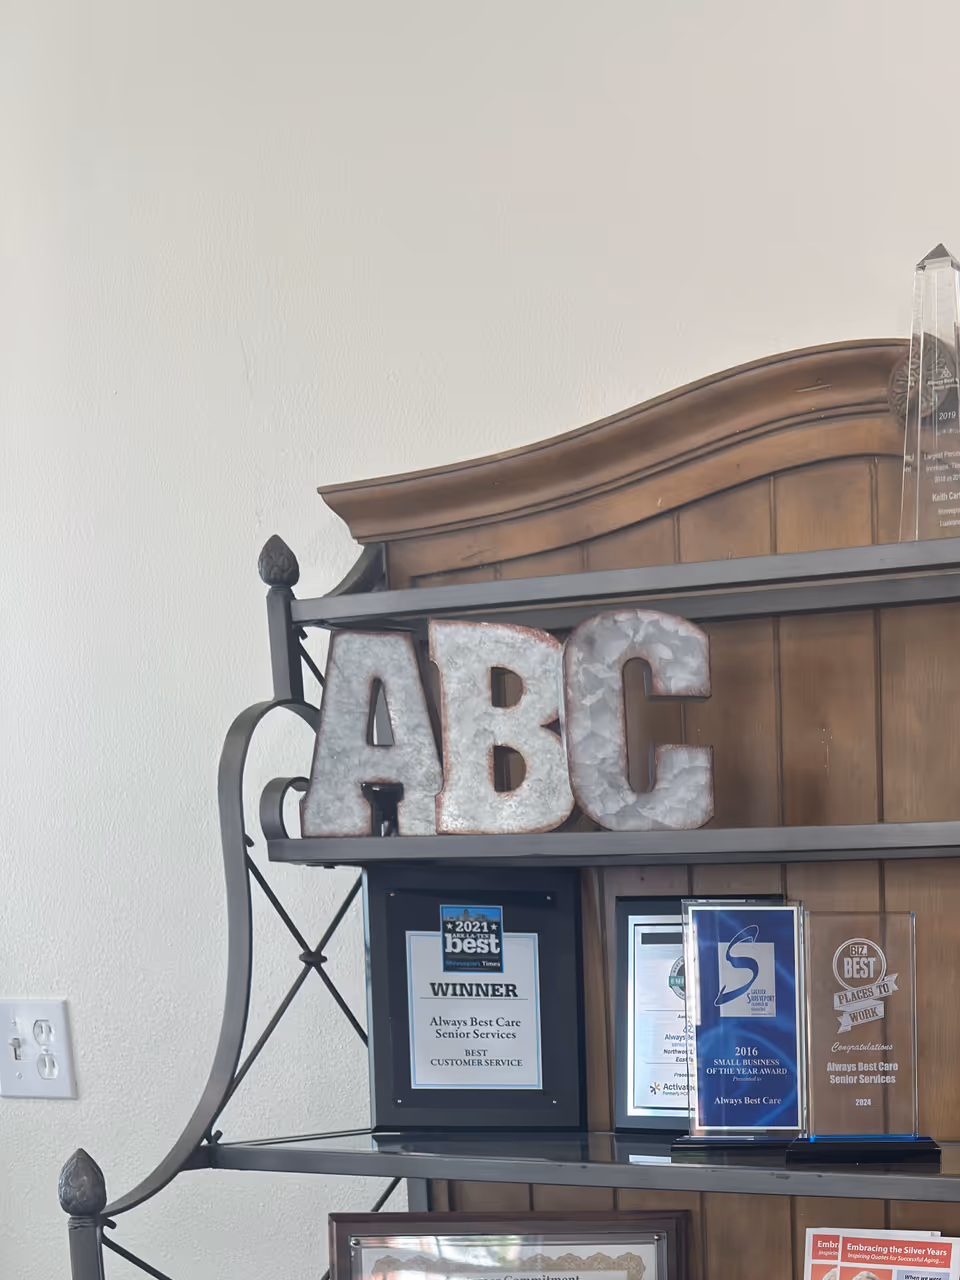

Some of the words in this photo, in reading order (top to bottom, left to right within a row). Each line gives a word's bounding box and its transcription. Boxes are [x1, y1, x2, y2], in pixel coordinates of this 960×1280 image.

[301, 608, 715, 838] ABC
[455, 921, 489, 932] 2021
[445, 933, 501, 954] best
[844, 957, 876, 979] BEST
[430, 982, 518, 998] WINNER
[838, 987, 874, 1005] PLACES
[876, 983, 890, 995] TO
[849, 1007, 879, 1023] WORK
[429, 1016, 468, 1029] Always
[470, 1017, 493, 1027] Best
[495, 1017, 521, 1027] Care
[435, 1029, 471, 1039] Senior
[473, 1029, 517, 1039] Services
[464, 1049, 488, 1057] BEST
[735, 1046, 758, 1056] 2016
[831, 1041, 893, 1054] Congratulations
[430, 1058, 483, 1067] CUSTOMER
[484, 1059, 523, 1067] SERVICE
[827, 1062, 857, 1072] Always
[858, 1062, 877, 1071] Best
[879, 1062, 898, 1071] Care
[830, 1074, 857, 1084] Senior
[859, 1074, 896, 1084] Services
[714, 1097, 742, 1105] Always
[744, 1097, 761, 1105] Best
[763, 1097, 781, 1105] Care
[855, 1098, 872, 1106] 2024
[847, 1243, 888, 1254] Embracing
[889, 1245, 903, 1253] the
[904, 1246, 925, 1255] Silver
[926, 1247, 947, 1256] Years
